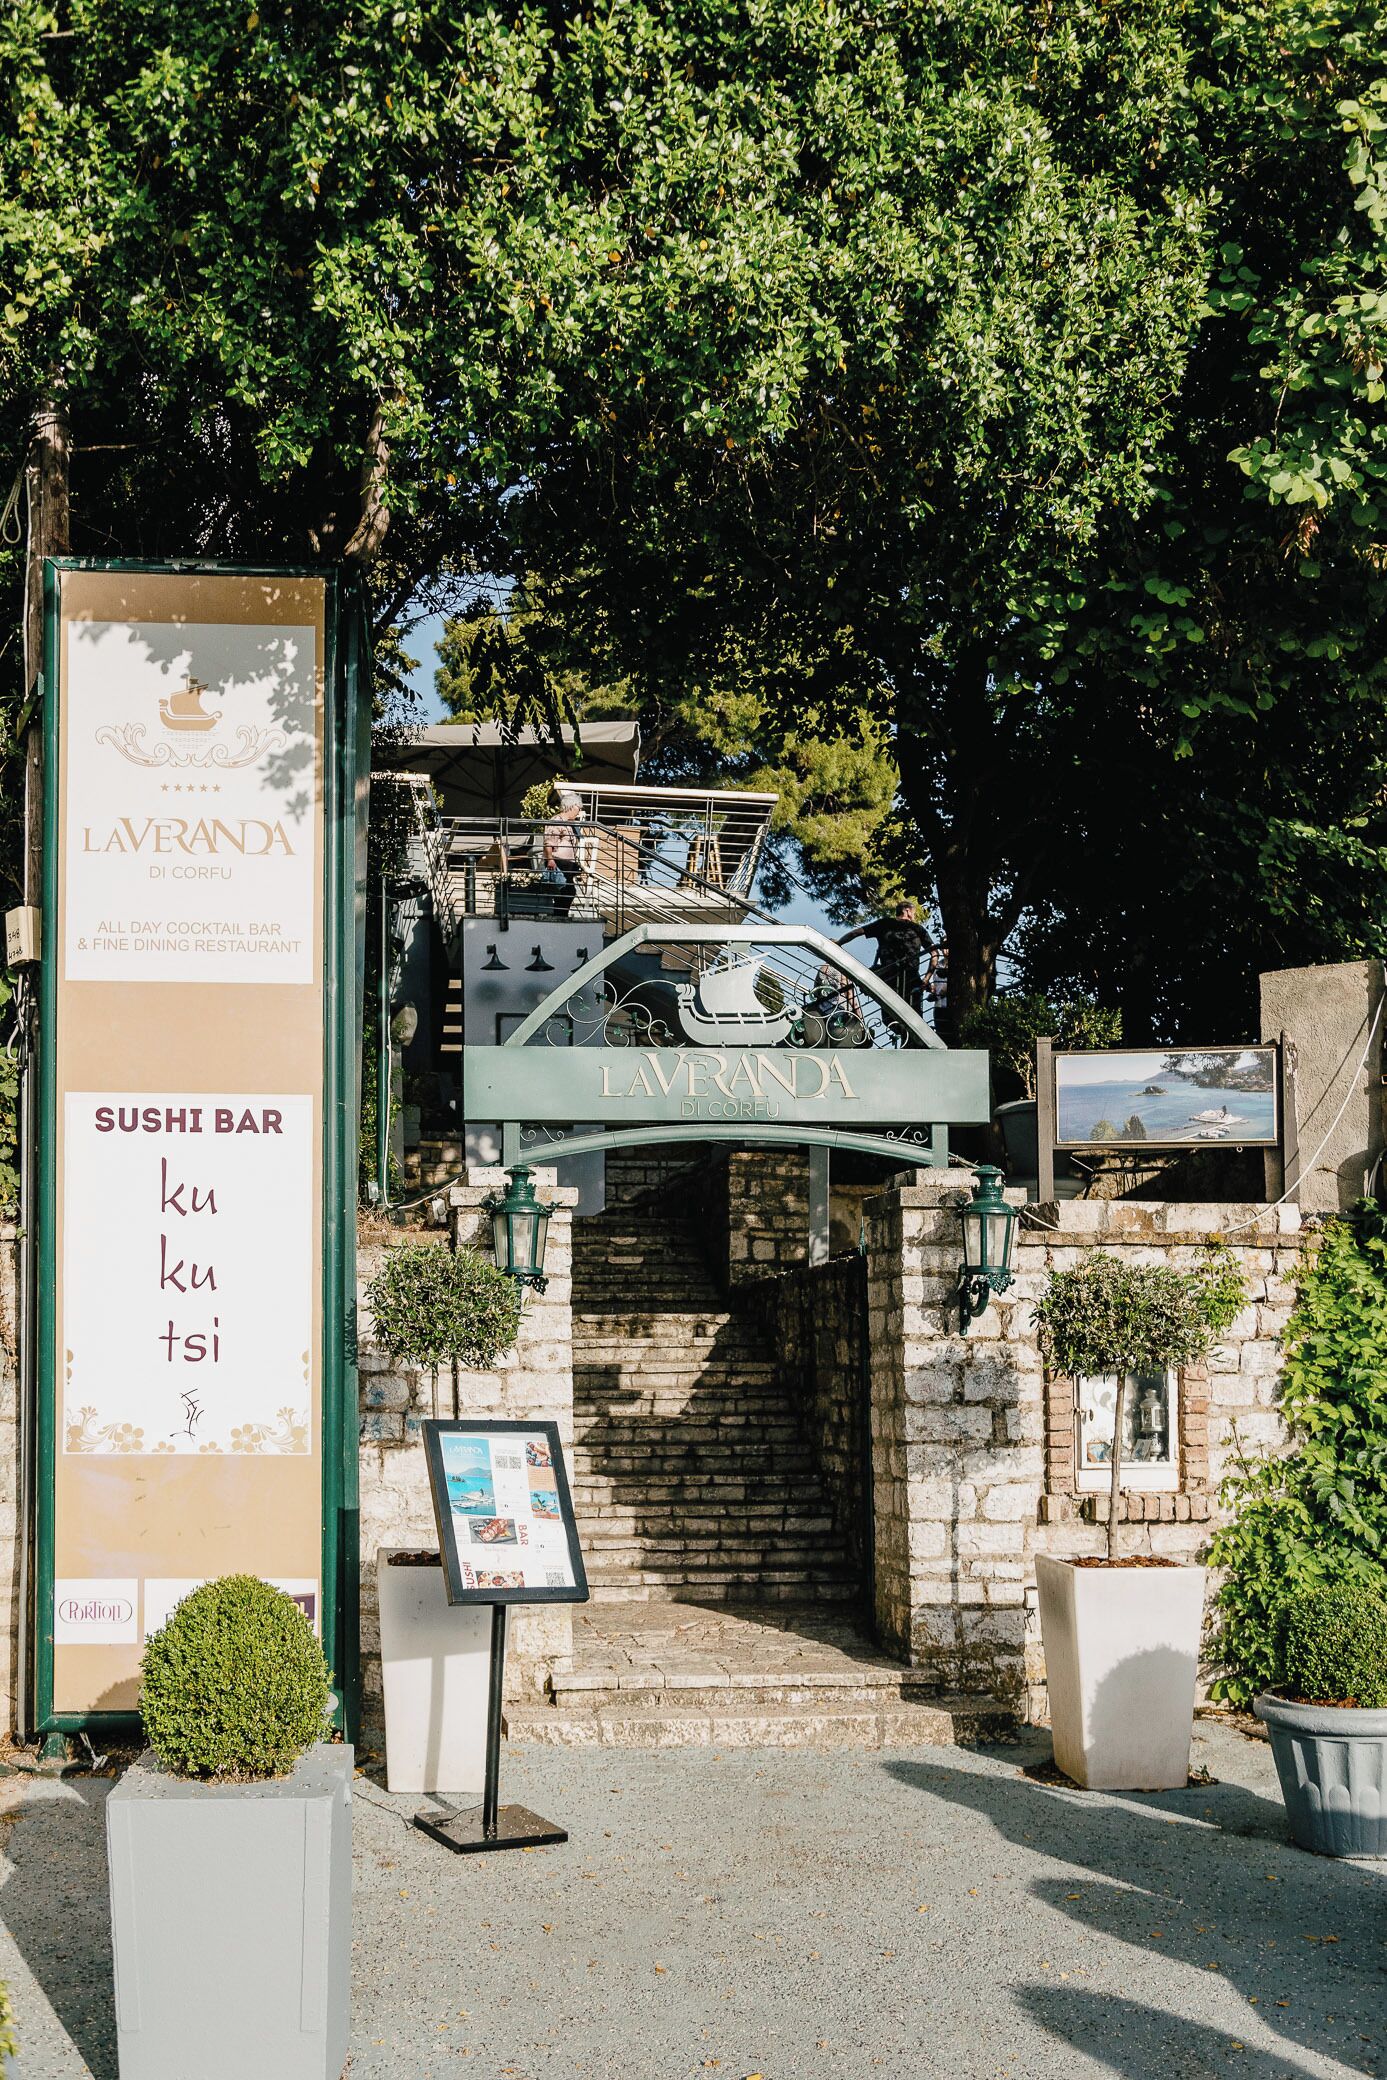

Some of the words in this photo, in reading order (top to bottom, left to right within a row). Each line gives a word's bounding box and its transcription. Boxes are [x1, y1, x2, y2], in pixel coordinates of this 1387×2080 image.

[149, 866, 166, 879] DI
[172, 866, 232, 880] CORFU
[97, 921, 126, 934] ALL
[131, 921, 162, 934] DAY
[166, 921, 244, 935] COCKTAIL
[249, 923, 281, 936] BAR
[77, 938, 88, 951] &
[93, 938, 129, 951] FINE
[134, 939, 190, 952] DINING
[195, 940, 302, 953] RESTAURANT
[95, 1107, 203, 1133] SUSHI
[214, 1108, 283, 1134] BAR
[681, 1101, 700, 1117] DI
[708, 1101, 779, 1118] CORFU
[161, 1157, 218, 1216] ku
[160, 1234, 218, 1293] ku
[158, 1317, 220, 1362] tsi
[518, 1524, 528, 1546] BAR
